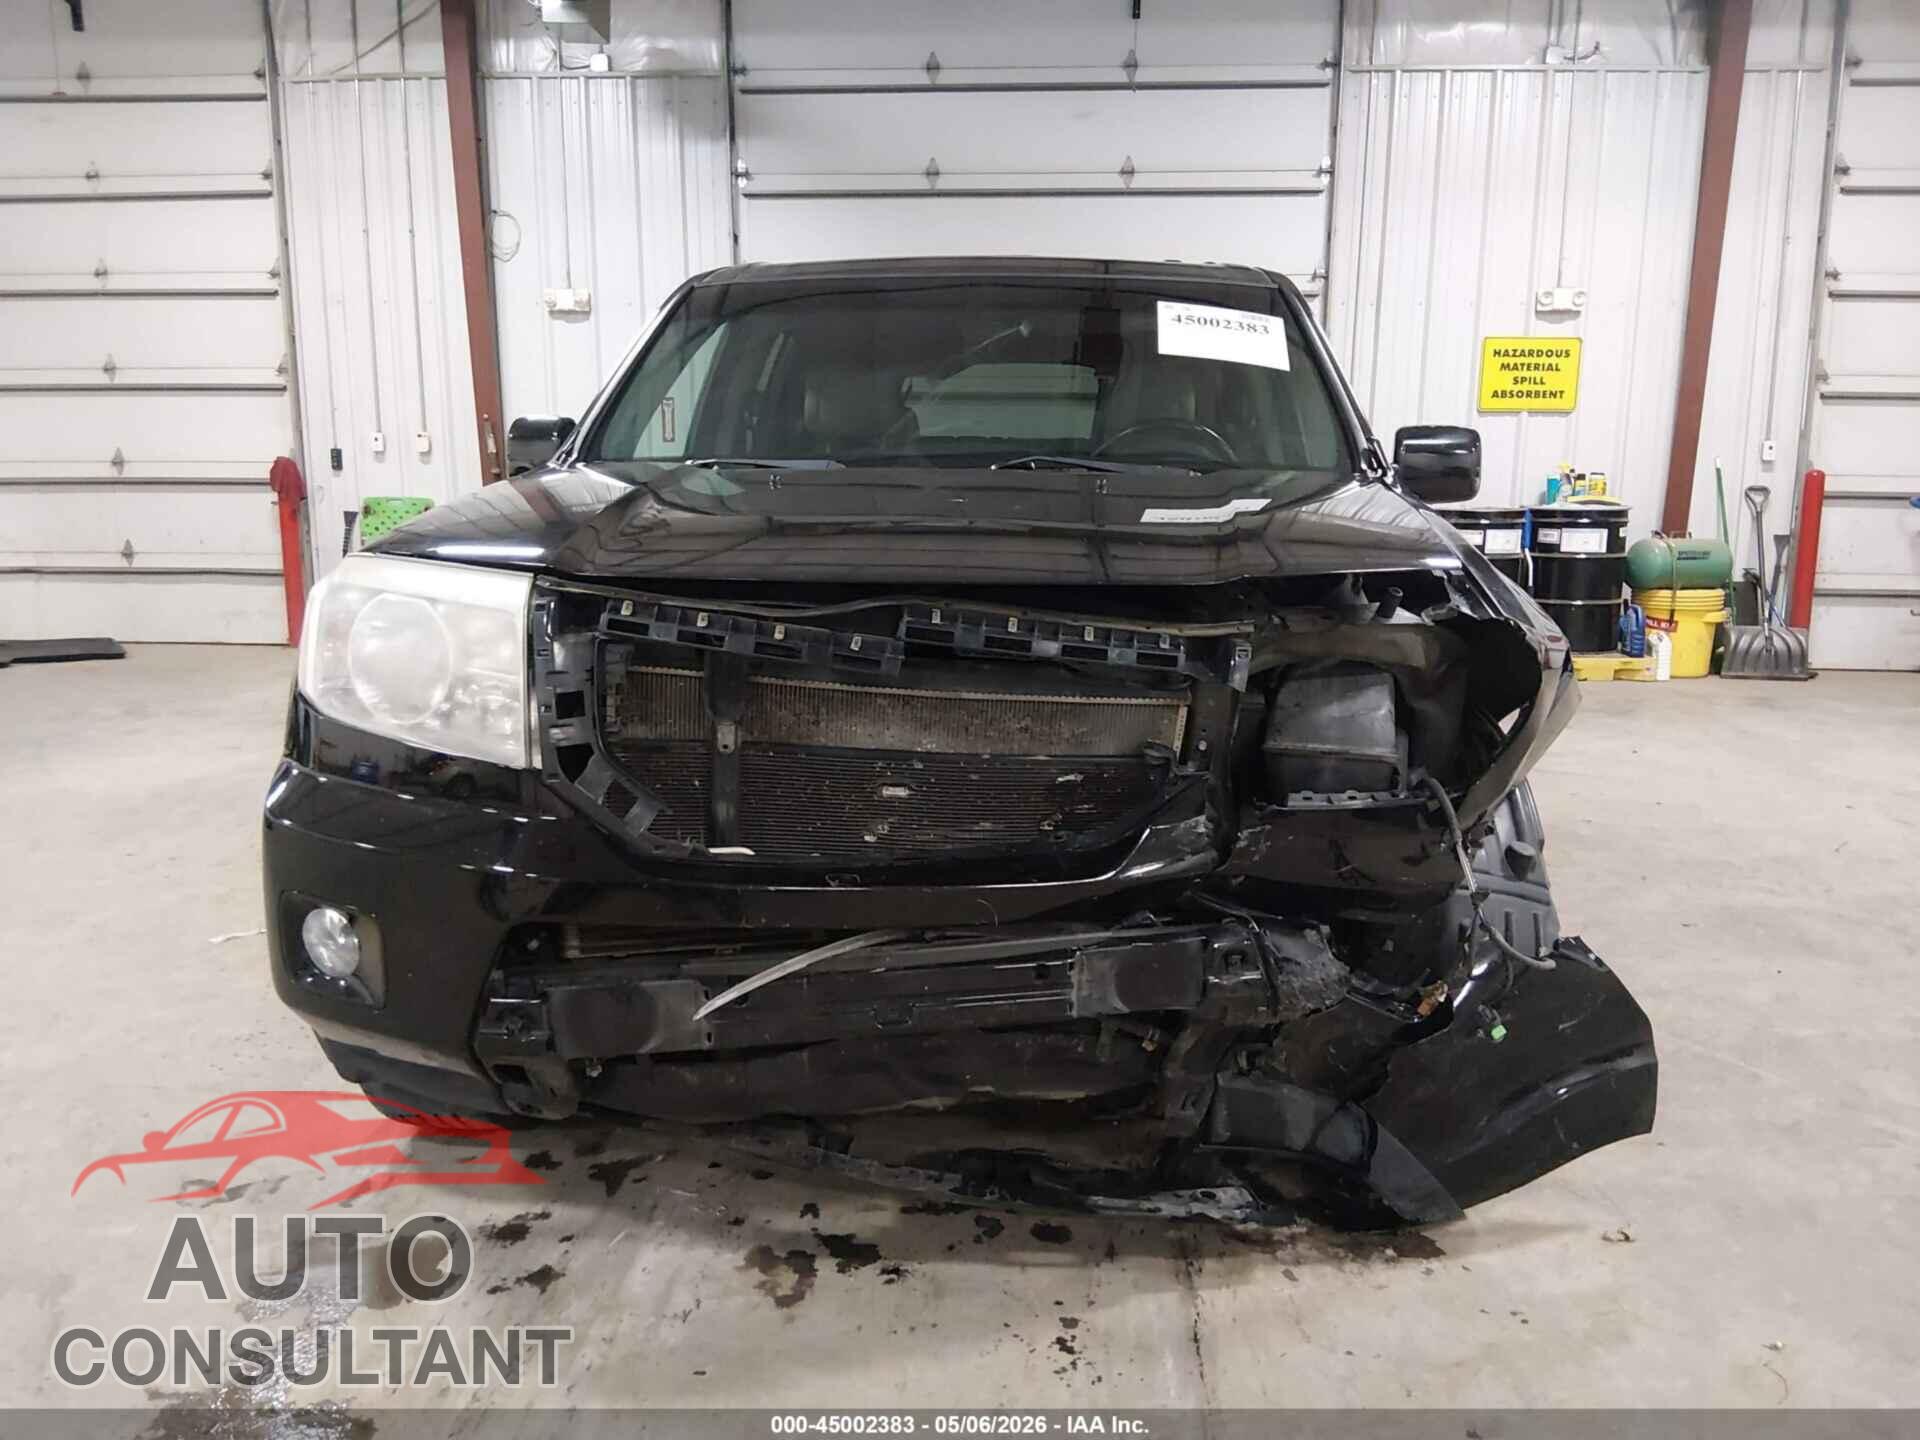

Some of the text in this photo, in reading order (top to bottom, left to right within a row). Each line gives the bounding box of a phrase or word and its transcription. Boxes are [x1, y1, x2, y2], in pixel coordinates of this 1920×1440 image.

[1171, 313, 1270, 335] 45002383
[1493, 349, 1571, 358] HAZARDOUS
[1499, 363, 1561, 372] MATERIAL
[1512, 376, 1546, 385] SPILL
[1491, 390, 1565, 399] ABSORBENT
